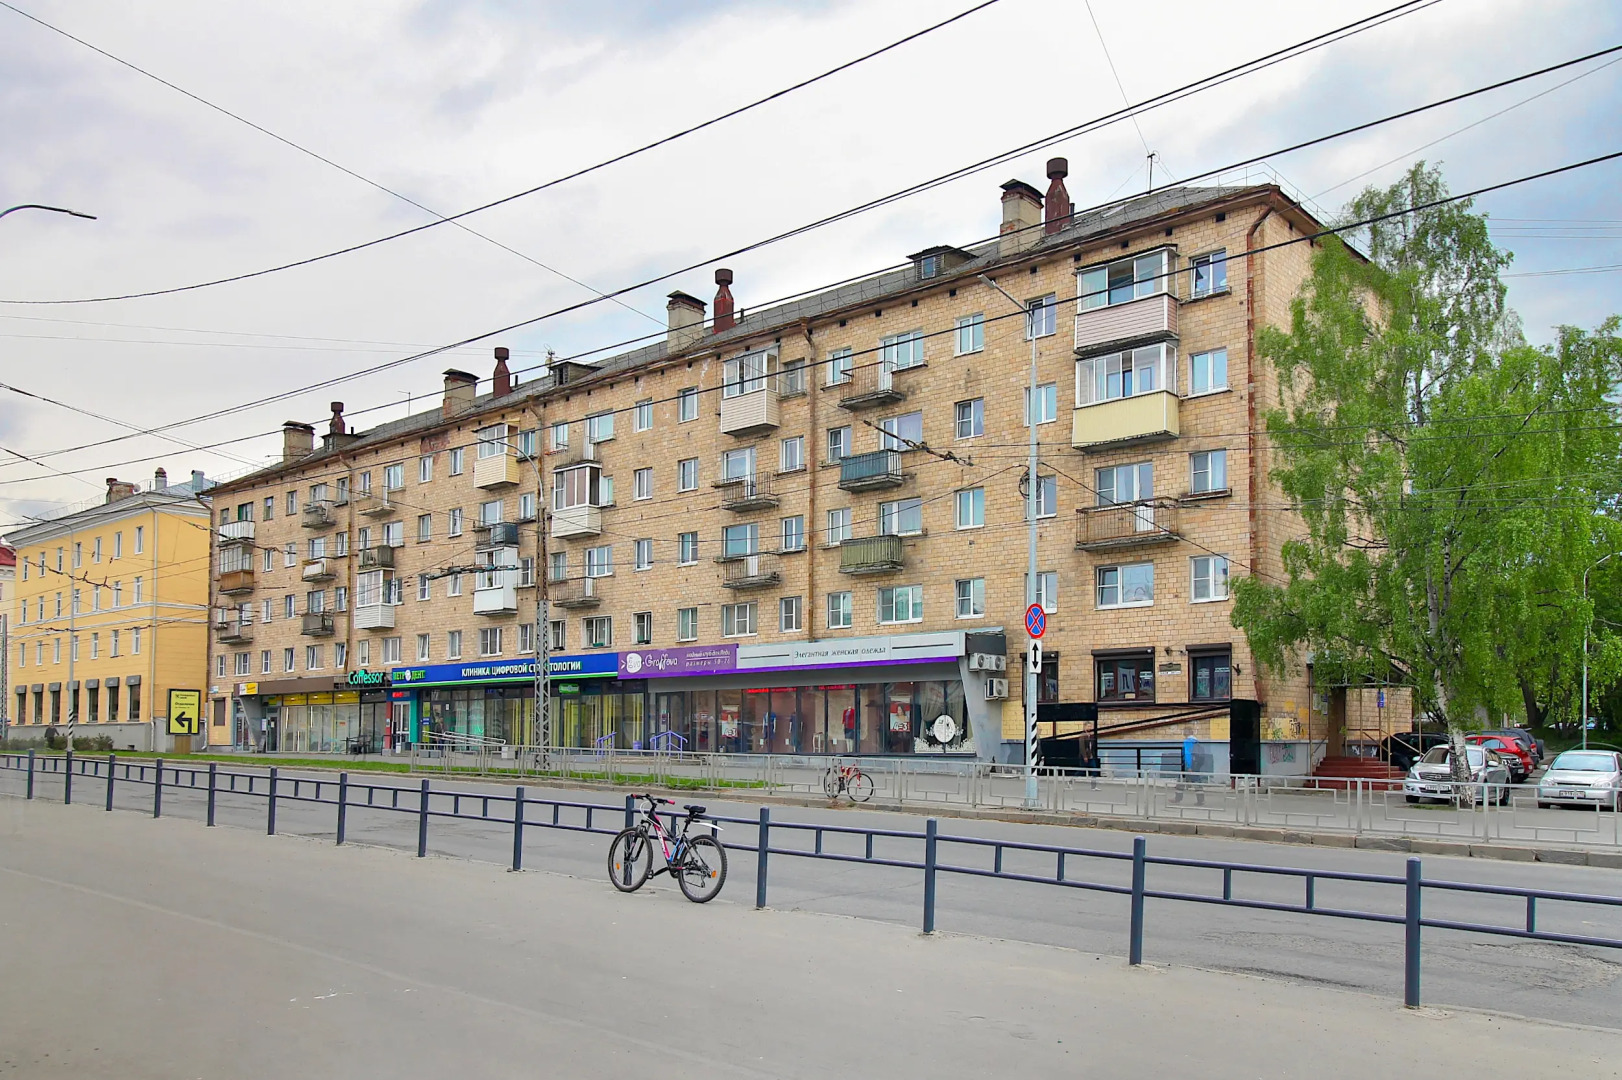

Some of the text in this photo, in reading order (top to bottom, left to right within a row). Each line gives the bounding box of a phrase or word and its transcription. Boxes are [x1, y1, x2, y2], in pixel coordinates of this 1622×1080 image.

[831, 648, 859, 656] женская
[461, 666, 490, 677] КЛИНИКА
[491, 663, 527, 676] ЦИФРОВОЙ
